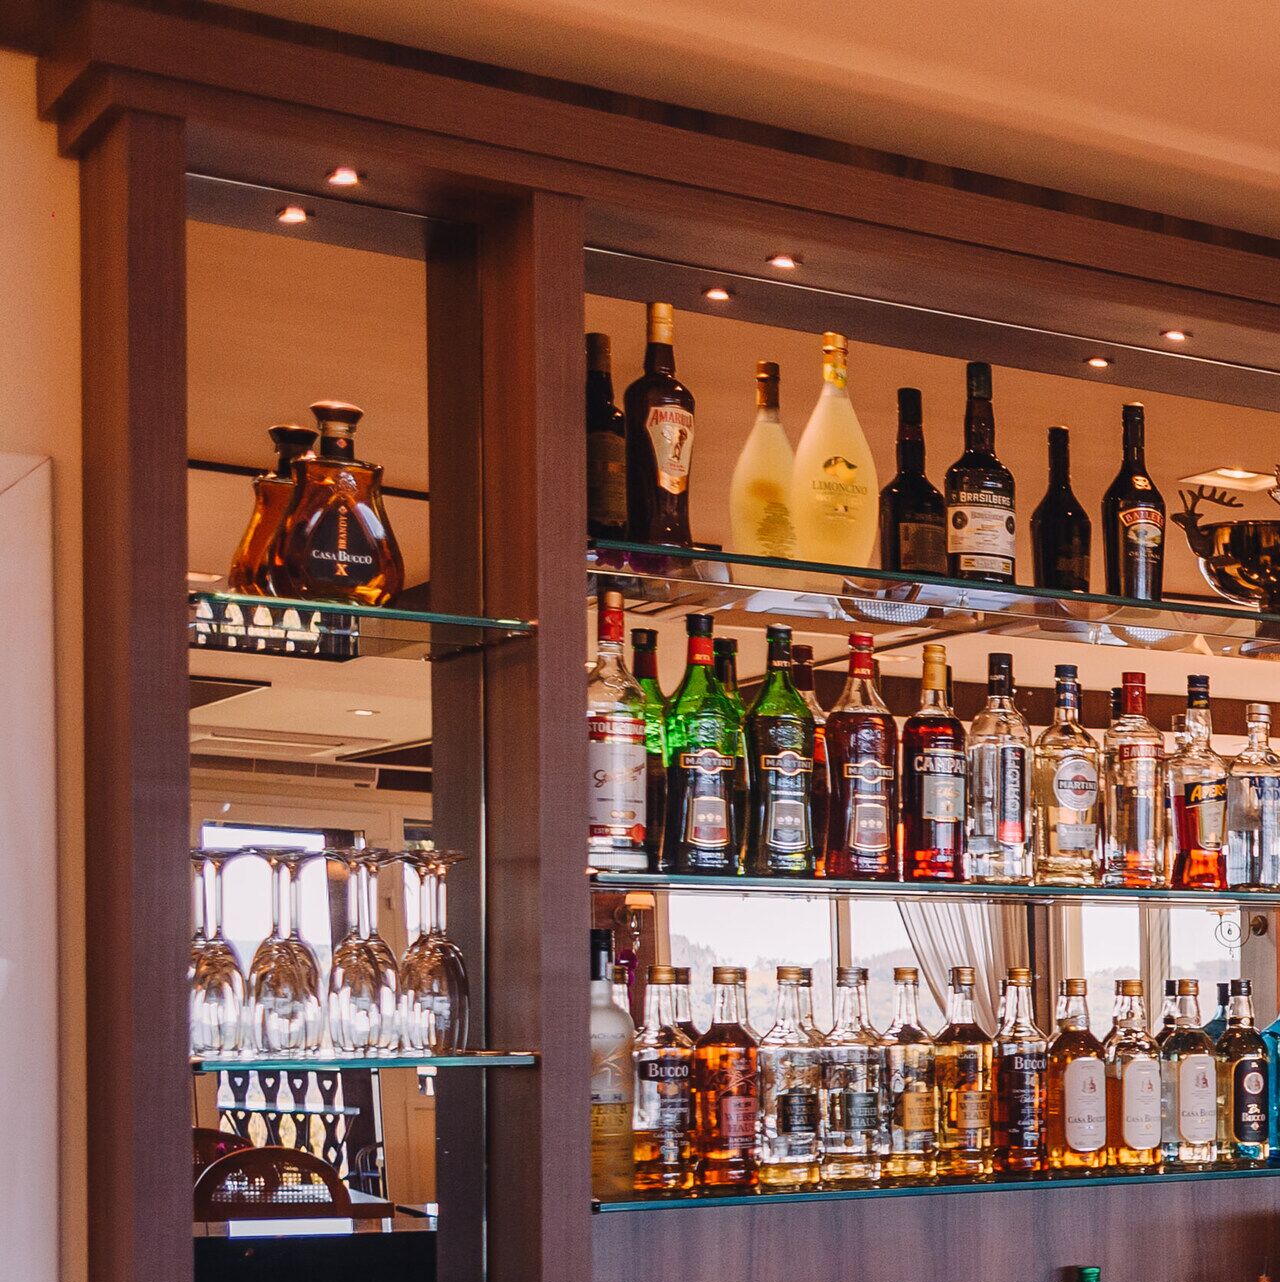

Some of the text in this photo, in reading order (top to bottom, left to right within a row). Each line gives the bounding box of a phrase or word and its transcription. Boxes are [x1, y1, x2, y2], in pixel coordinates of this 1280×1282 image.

[312, 549, 373, 564] CASA BUCCO
[335, 563, 348, 576] X
[685, 756, 732, 767] MARTINI
[648, 1062, 690, 1079] BUCCO
